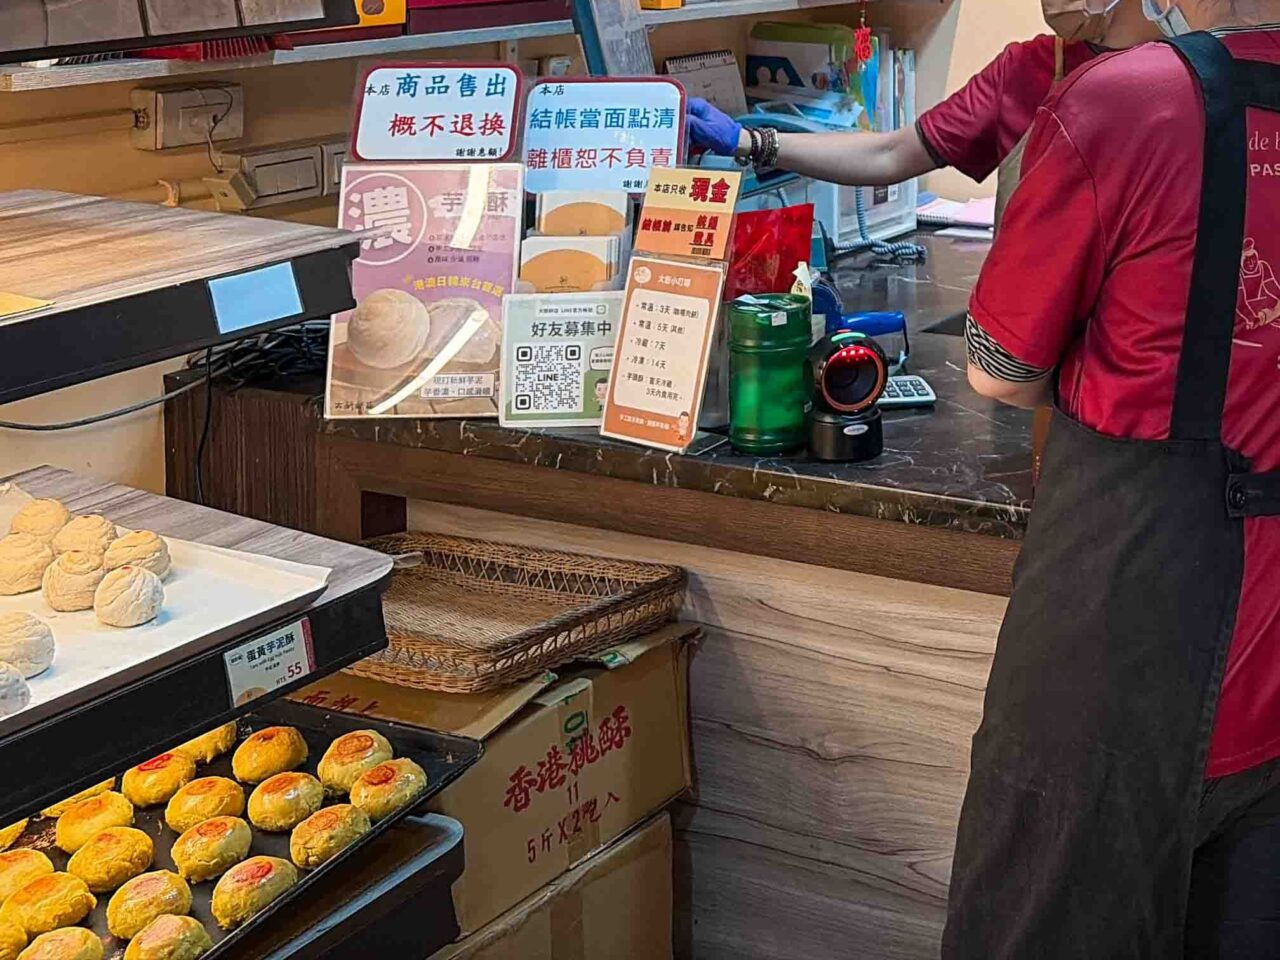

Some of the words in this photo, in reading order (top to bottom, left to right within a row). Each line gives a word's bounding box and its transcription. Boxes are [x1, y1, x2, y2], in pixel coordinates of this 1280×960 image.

[365, 83, 390, 96] 本店
[396, 73, 506, 98] 商品售出
[540, 84, 565, 96] 本店
[388, 112, 506, 137] 概不退換
[529, 107, 675, 129] 結帳當面點清
[527, 147, 672, 169] 離櫃恕不負責
[623, 180, 648, 189] 謝謝
[654, 183, 687, 194] 本店只收
[689, 177, 730, 203] 現金
[348, 186, 412, 250] 濃
[531, 320, 612, 337] 好友募集中
[246, 631, 295, 663] 蛋黃芋泥酥
[287, 661, 302, 678] 55
[504, 706, 631, 812] 香港桃酥
